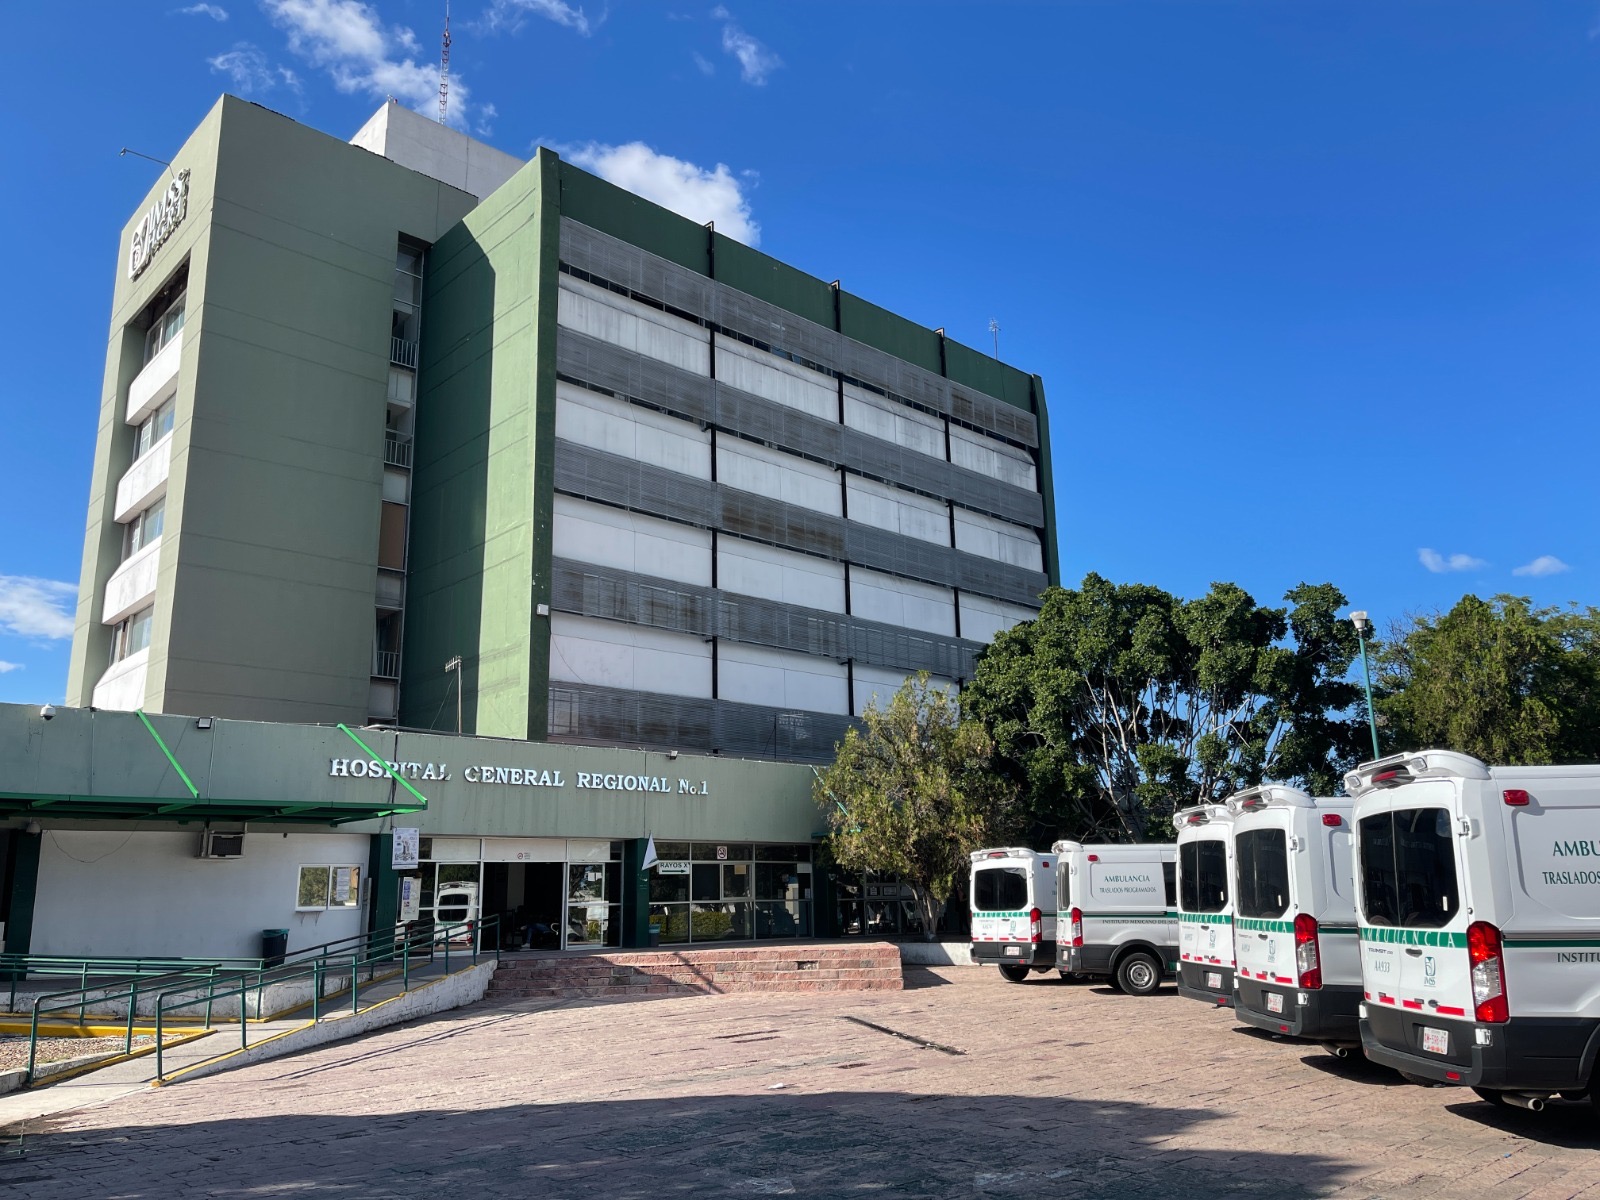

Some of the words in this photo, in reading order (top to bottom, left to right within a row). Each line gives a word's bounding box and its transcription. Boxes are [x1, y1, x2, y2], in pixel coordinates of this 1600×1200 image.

[329, 758, 452, 780] HOSPITAL
[464, 764, 565, 787] GENERAL
[576, 771, 671, 793] REGIONAL
[678, 778, 709, 795] No.1
